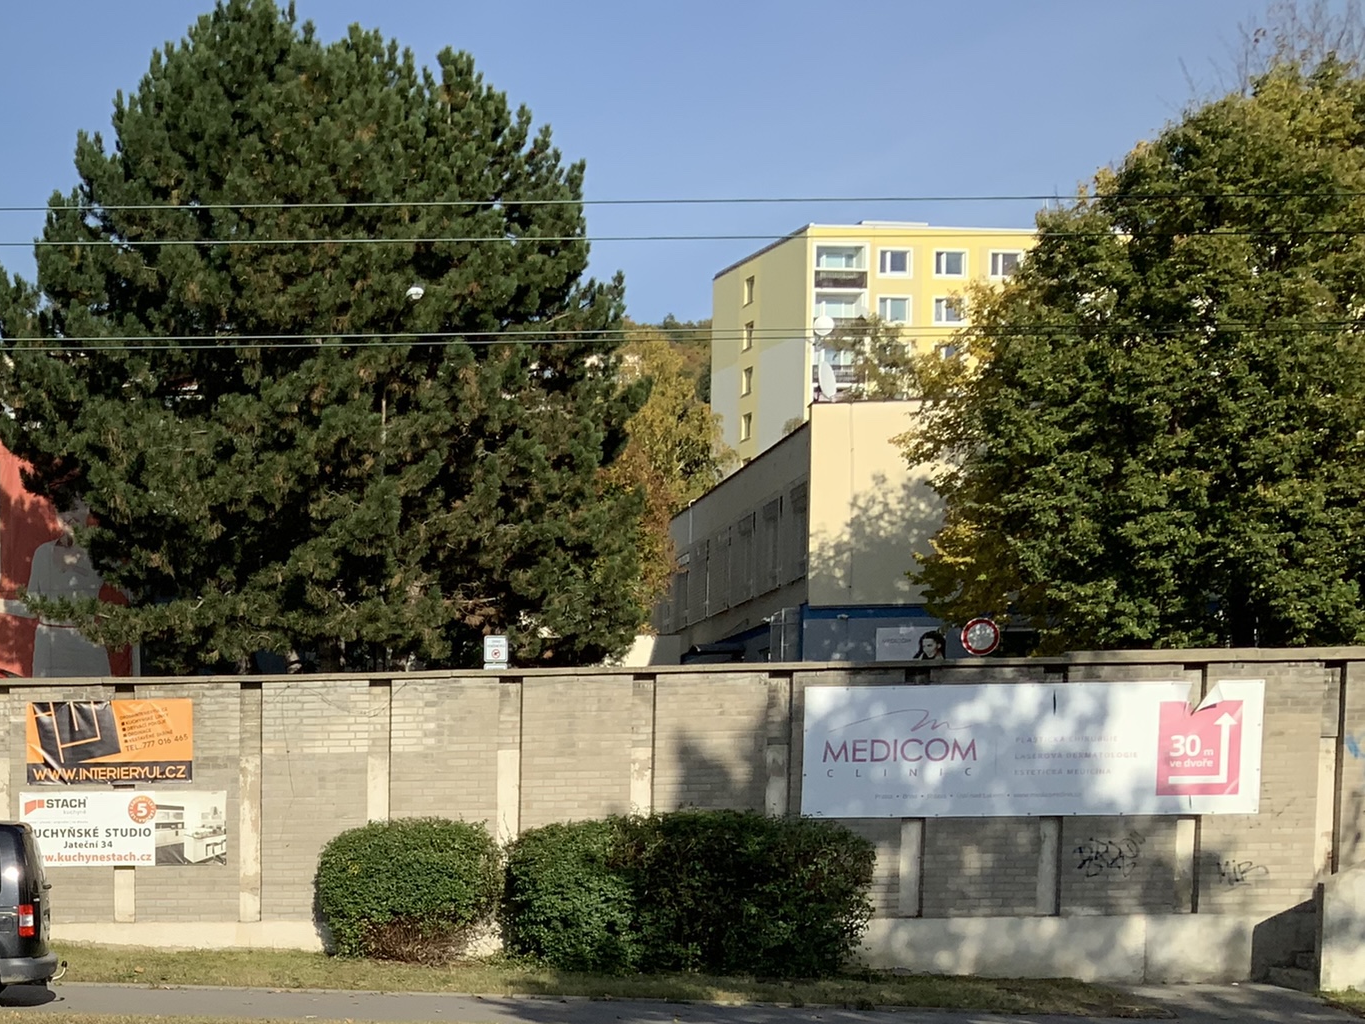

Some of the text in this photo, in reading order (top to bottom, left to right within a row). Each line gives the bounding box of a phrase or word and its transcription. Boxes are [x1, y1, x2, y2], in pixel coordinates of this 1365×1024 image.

[142, 740, 155, 749] 777
[157, 738, 172, 746] 016
[174, 733, 189, 742] 465
[1169, 735, 1214, 757] 30 m
[822, 738, 978, 763] MEDICOM
[1169, 758, 1213, 768] ve dvoře
[32, 765, 187, 781] WWW.INTERIERYUL.CZ
[46, 798, 87, 809] STACH
[136, 803, 148, 816] 5
[35, 826, 152, 839] UCHYŇSKÉ STUDIO
[64, 840, 113, 849] Jateční 34
